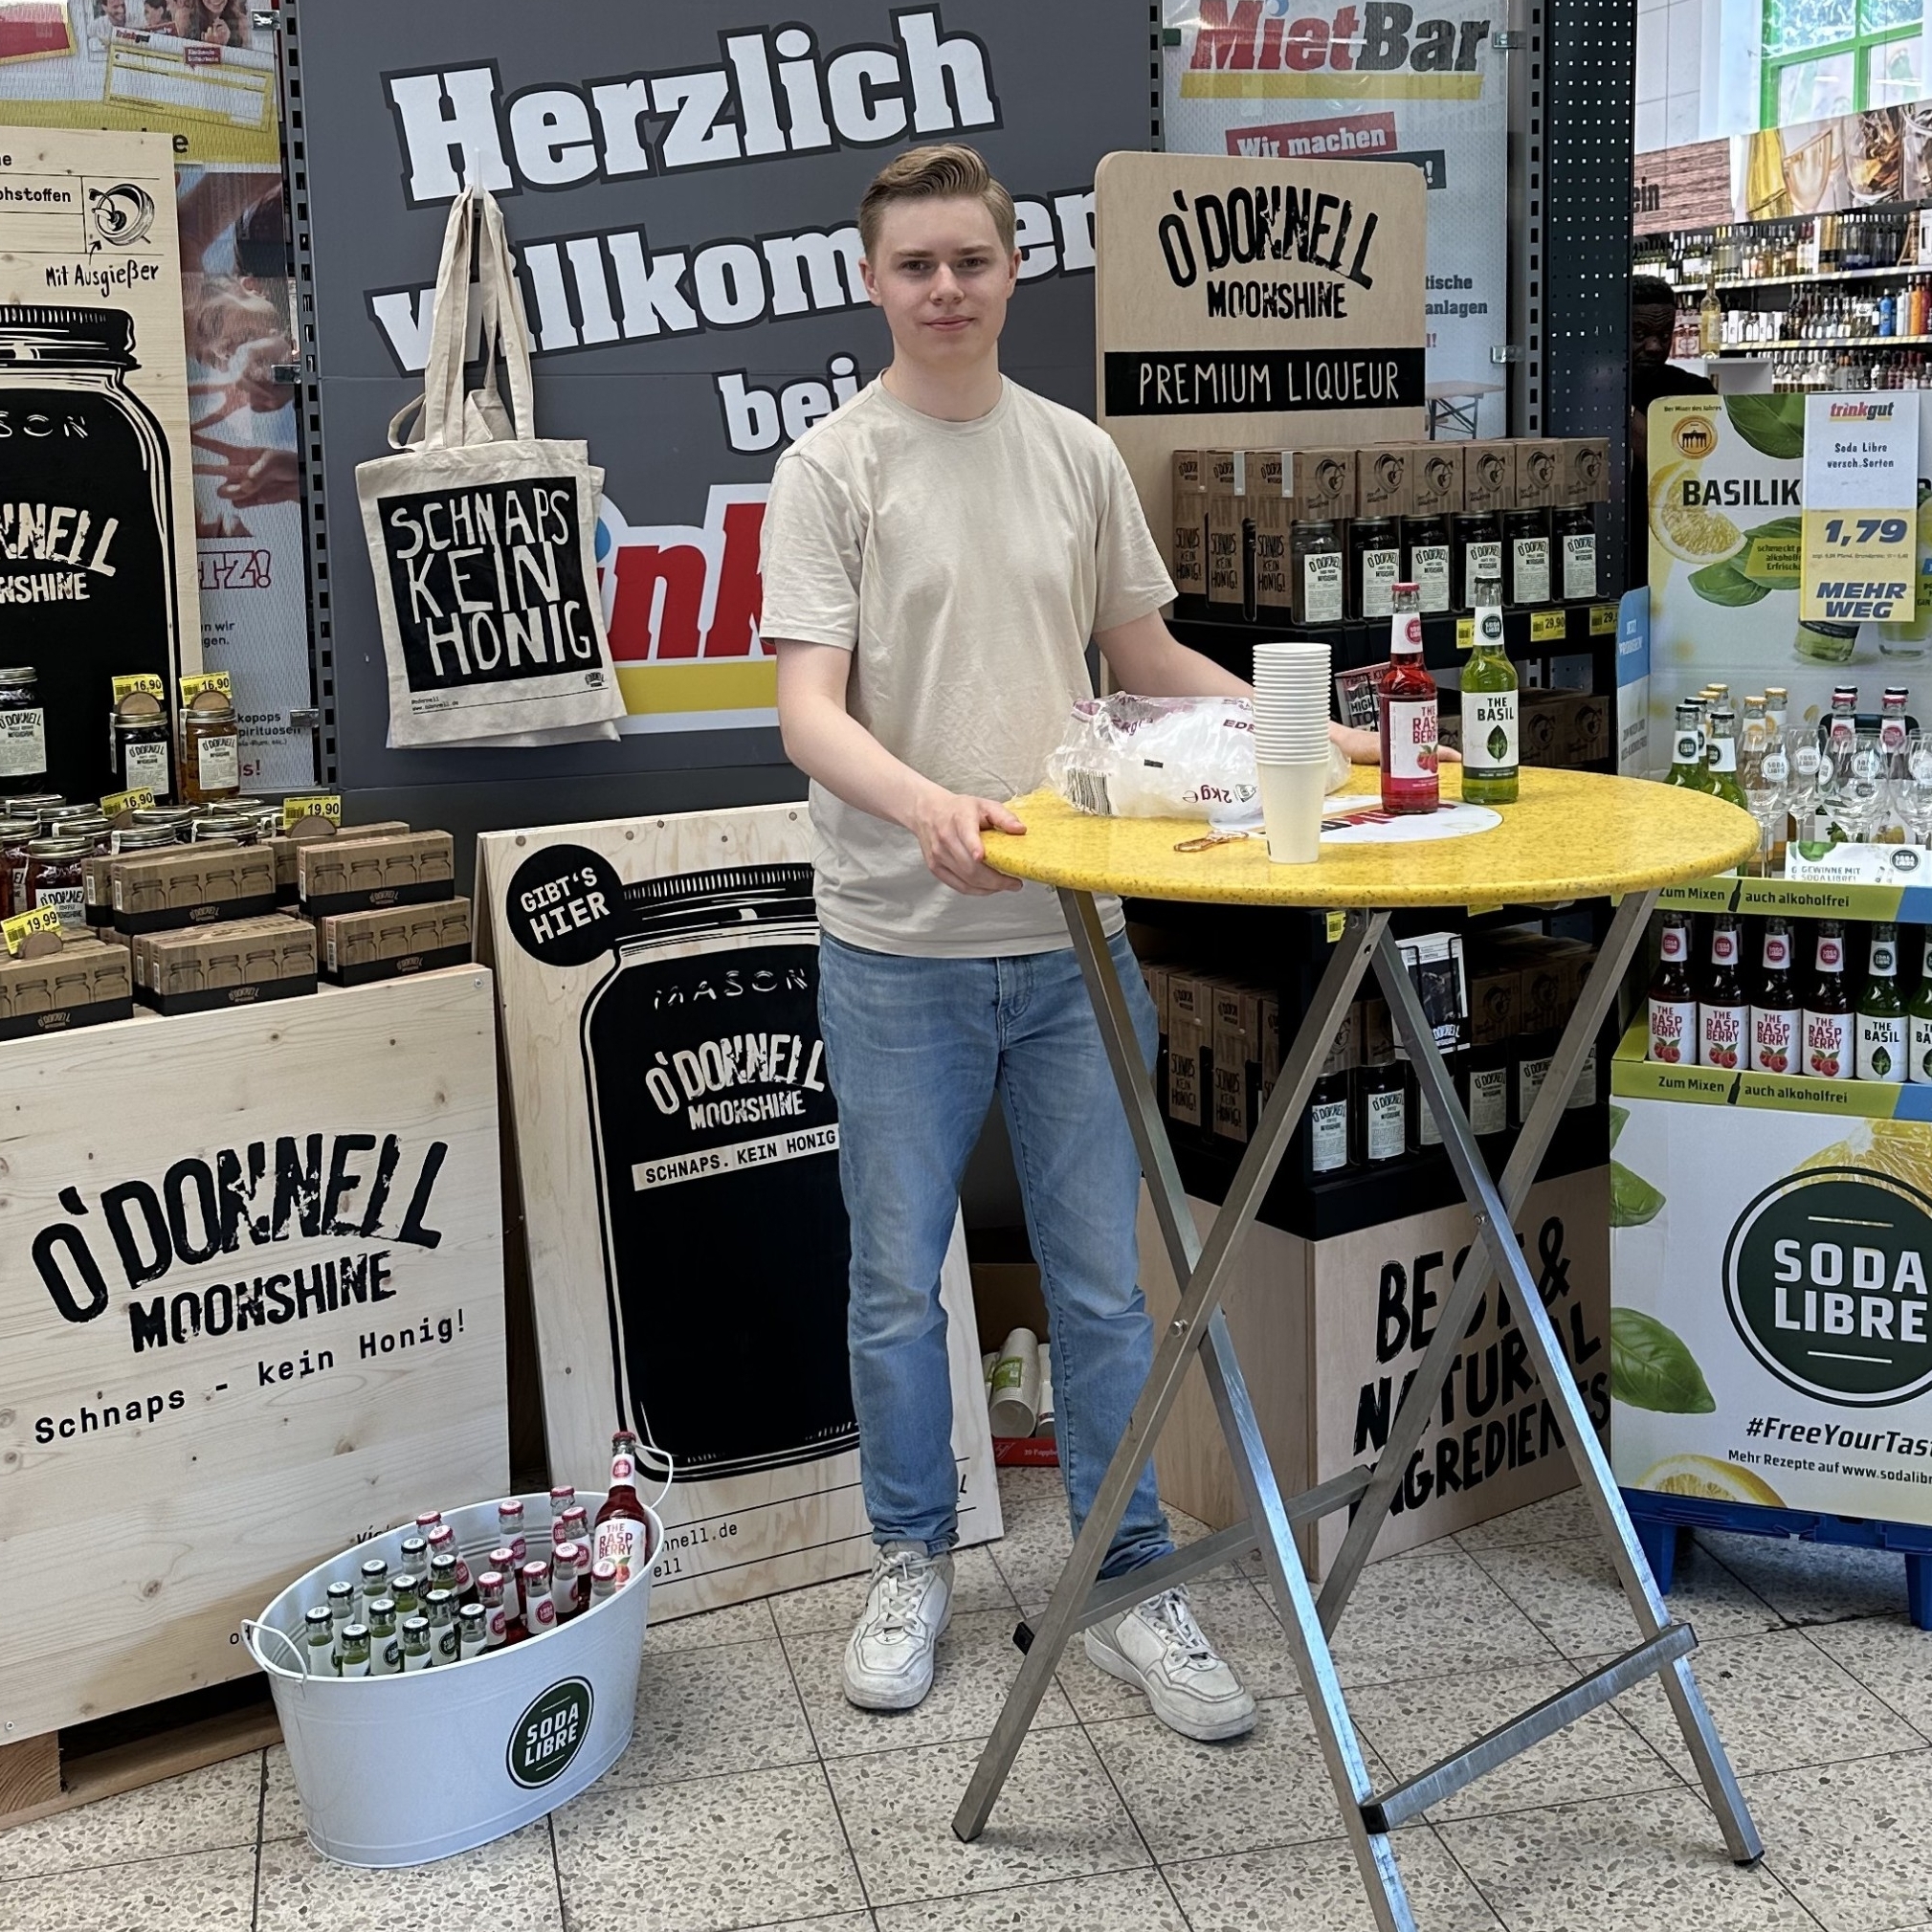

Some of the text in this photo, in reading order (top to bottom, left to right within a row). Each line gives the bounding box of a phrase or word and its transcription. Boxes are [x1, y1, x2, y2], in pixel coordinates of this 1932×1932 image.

[1190, 0, 1490, 72] MietBar
[387, 8, 1000, 205] Herzlich
[1237, 126, 1387, 157] Wir machen
[1158, 185, 1379, 290] O'DONNELL
[46, 259, 160, 298] Mit Ausgießer
[1207, 280, 1347, 321] MOONSHINE
[1140, 361, 1400, 405] PREMIUM LIQUEUR
[1830, 400, 1895, 421] trinkgut
[1834, 442, 1888, 454] Soda Libre
[1682, 479, 1801, 506] BASILIK
[389, 487, 570, 560] SCHNAPS
[1825, 518, 1908, 546] 1,79
[406, 540, 562, 624] KEIN
[1816, 582, 1907, 599] MEHR
[1826, 601, 1895, 619] WEG
[215, 620, 235, 632] wir
[426, 600, 592, 677] HONIG
[134, 678, 162, 692] 16,90
[202, 677, 230, 691] 16,90
[1487, 697, 1507, 708] THE
[235, 712, 281, 726] kopops
[1477, 707, 1515, 722] BASIL
[240, 759, 261, 777] s!
[122, 791, 153, 810] 16,90
[307, 802, 340, 815] 19,90
[1844, 867, 1861, 876] MIT
[520, 866, 598, 913] GIBT'S
[1688, 887, 1725, 901] Mixen
[1745, 891, 1850, 907] auch alkoholfrei
[27, 910, 57, 932] 19,99
[529, 891, 611, 944] HIER
[1656, 1005, 1675, 1015] THE
[1713, 1010, 1732, 1020] THE
[1764, 1013, 1782, 1024] THE
[1652, 1014, 1682, 1030] RASP
[1652, 1024, 1682, 1037] BERRY
[1706, 1018, 1740, 1033] RASP
[1757, 1021, 1790, 1036] RASP
[1815, 1016, 1834, 1028] THE
[1873, 1021, 1893, 1032] THE
[1706, 1028, 1740, 1043] BERRY
[1757, 1032, 1790, 1047] BERRY
[1809, 1024, 1842, 1039] RASP
[1864, 1029, 1900, 1043] BASIL
[1808, 1035, 1842, 1051] BERRY
[645, 1033, 826, 1115] O'DONNELL
[1658, 1076, 1725, 1093] Zum Mixen
[1744, 1084, 1848, 1103] auch alkoholfrei
[687, 1089, 807, 1130] MOONSHINE
[645, 1128, 836, 1184] SCHNAPS. KEIN HONIG
[32, 1133, 449, 1323] O'DONNELL
[1774, 1238, 1929, 1295] SODA
[128, 1250, 397, 1353] MOONSHINE
[1774, 1286, 1928, 1344] LIBRE
[34, 1388, 186, 1445] Schnaps
[257, 1348, 336, 1388] kein
[359, 1308, 467, 1360] Honig!
[1745, 1416, 1932, 1457] #FreeYourTas
[1728, 1449, 1762, 1465] Mehr
[1764, 1454, 1815, 1472] Rezepte
[1818, 1461, 1840, 1474] auf
[607, 1522, 625, 1532] THE
[599, 1532, 633, 1547] RASP
[599, 1543, 633, 1558] BERRY
[526, 1701, 580, 1747] SODA
[524, 1720, 579, 1768] LIBRE
